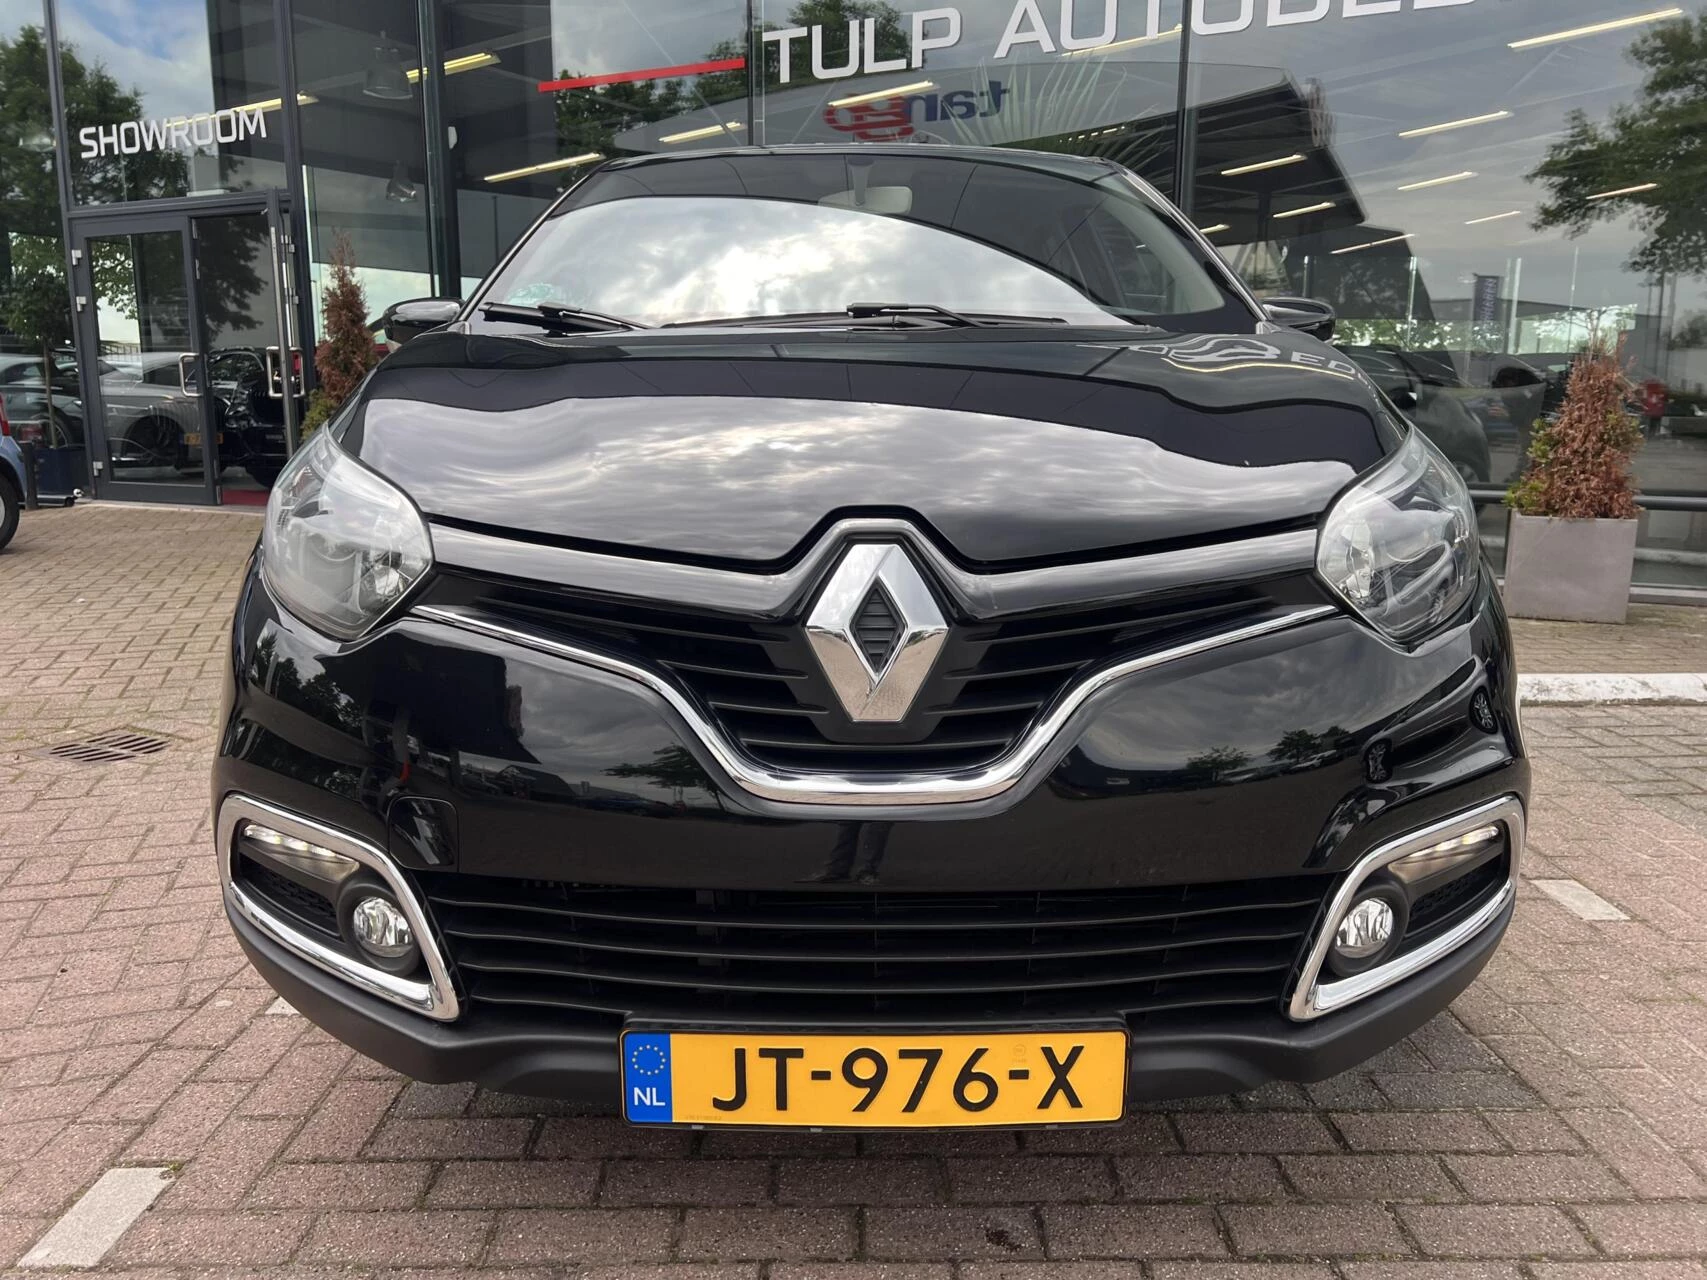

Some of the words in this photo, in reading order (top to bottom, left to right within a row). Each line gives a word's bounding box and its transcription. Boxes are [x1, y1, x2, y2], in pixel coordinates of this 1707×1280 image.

[762, 7, 961, 83] TULP
[993, 0, 1476, 59] AUTO
[79, 107, 267, 159] SHOWROOM
[633, 1087, 666, 1106] NL
[712, 1045, 1085, 1113] JT-976-X
